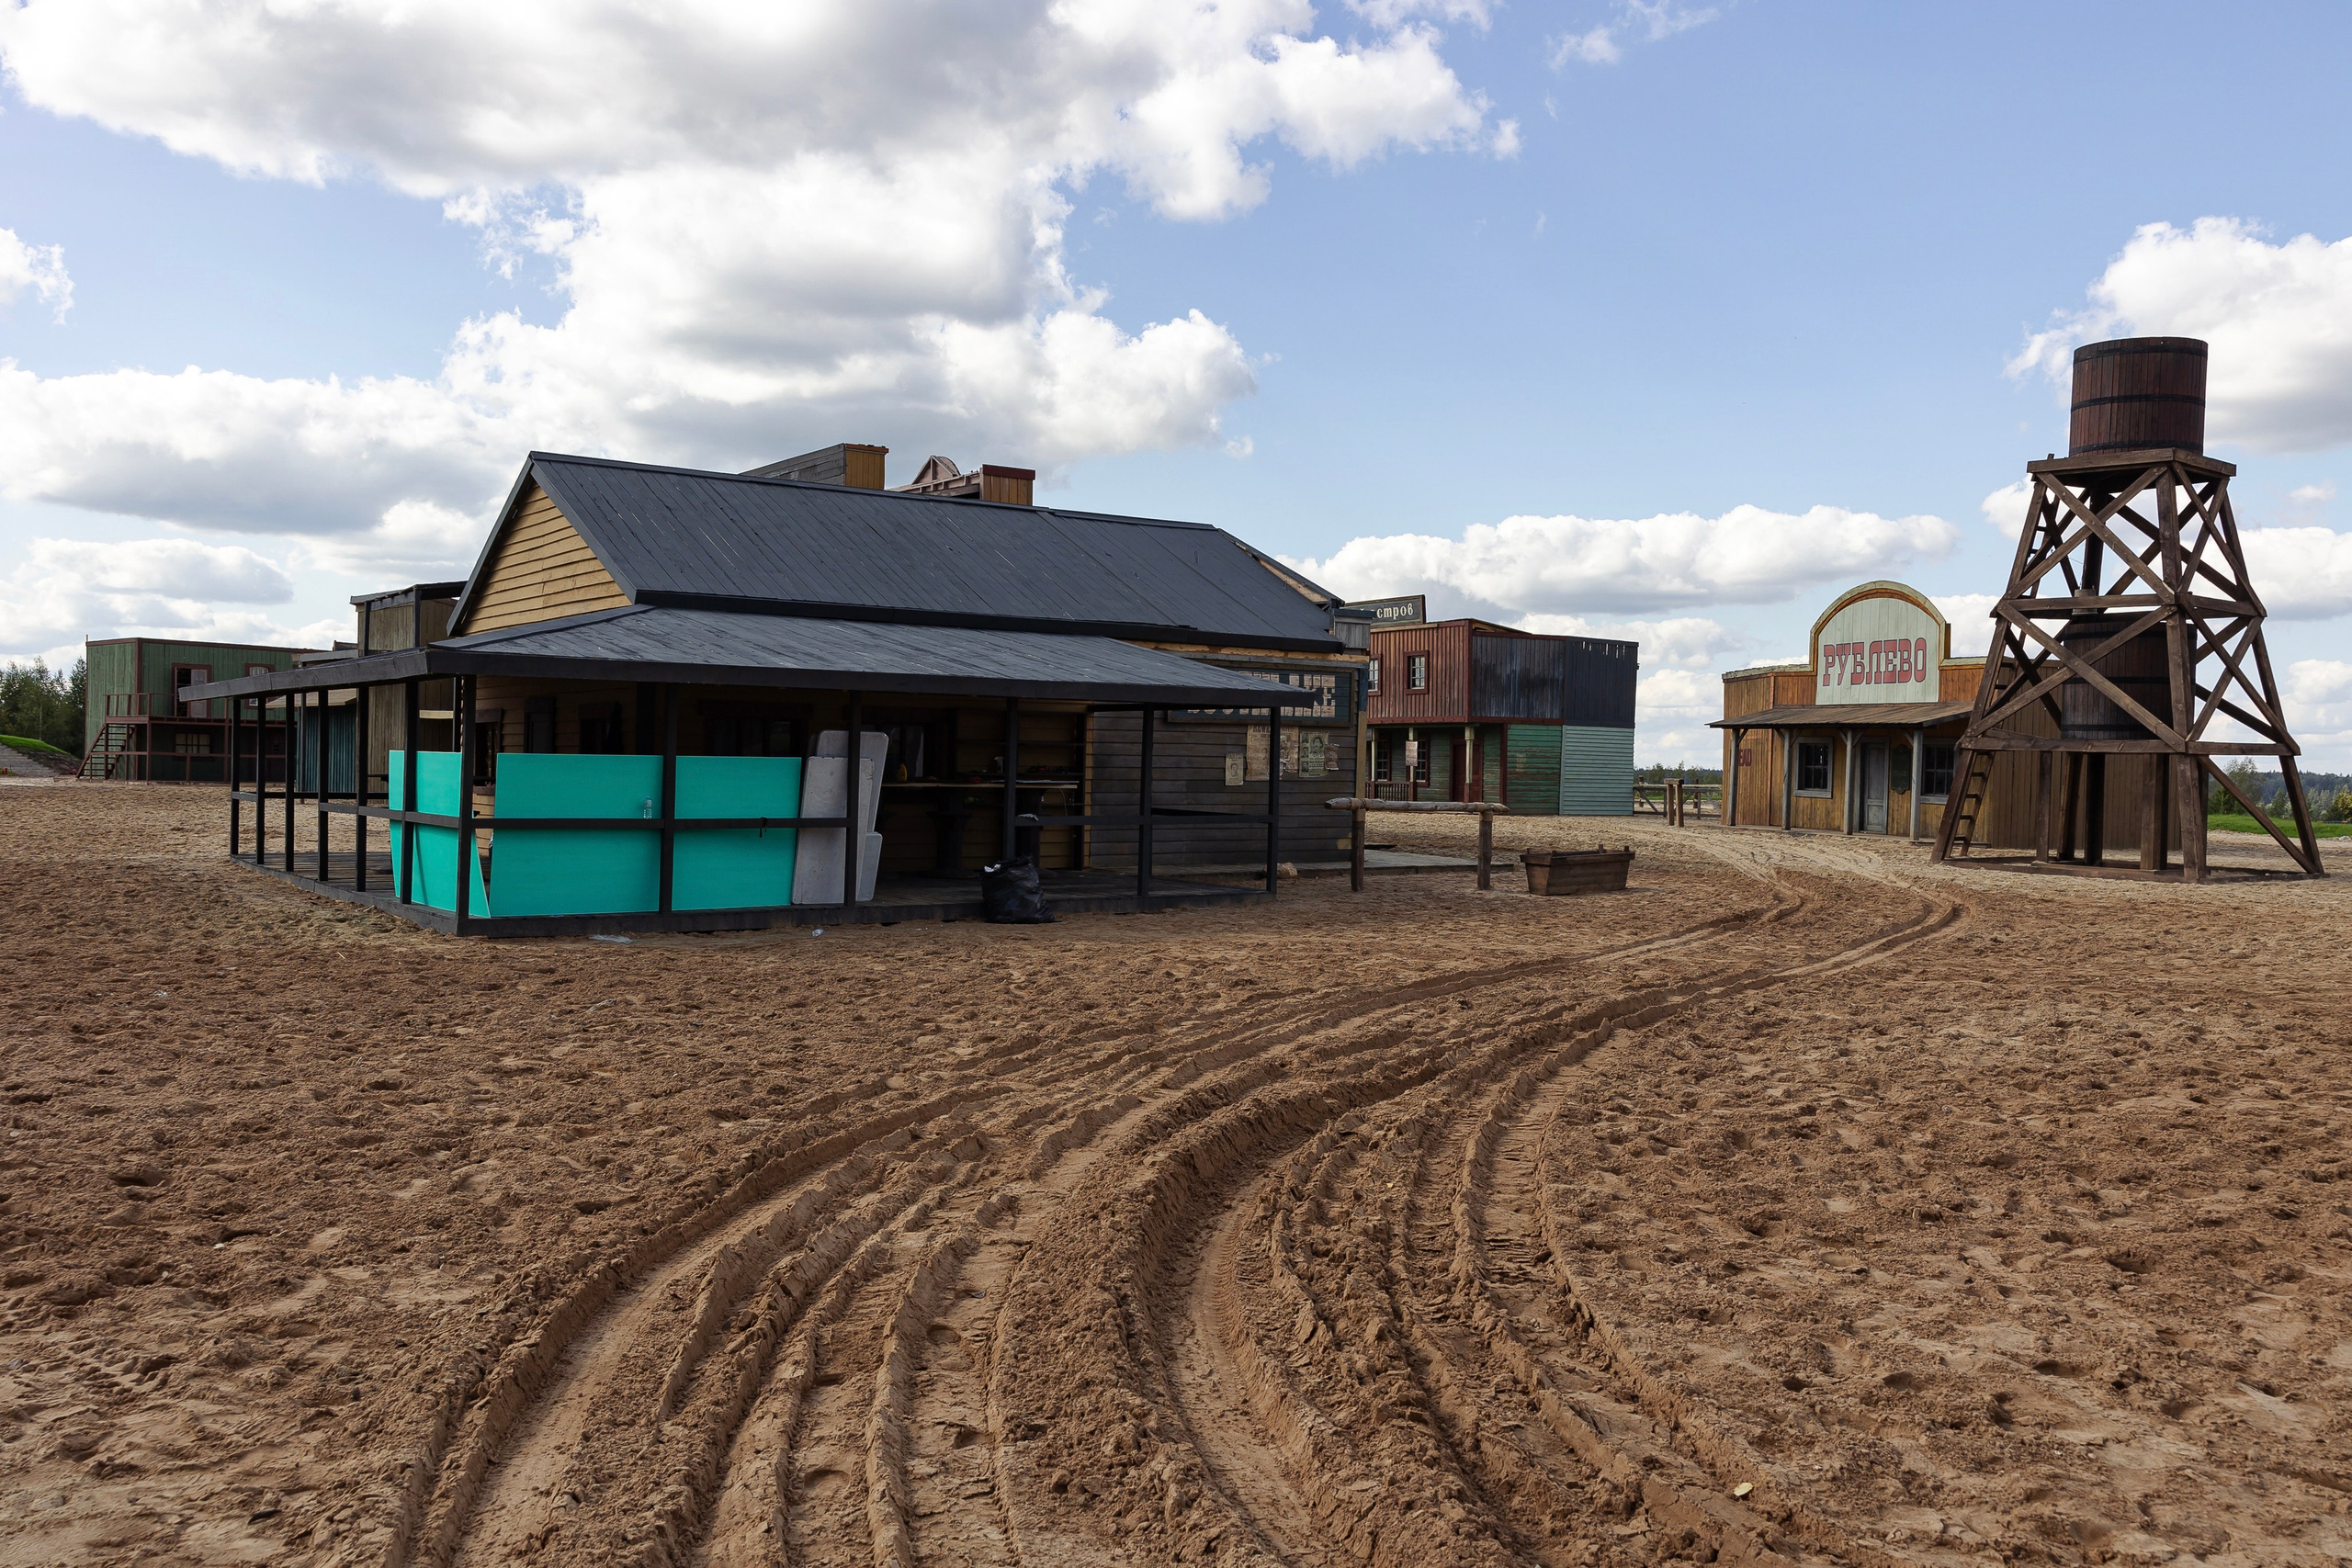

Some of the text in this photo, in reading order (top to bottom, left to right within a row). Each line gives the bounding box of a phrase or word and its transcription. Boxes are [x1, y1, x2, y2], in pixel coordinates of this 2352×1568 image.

[1371, 603, 1413, 620] стров
[1823, 637, 1927, 686] РУБЛЕВО
[1731, 749, 1752, 767] EAD
